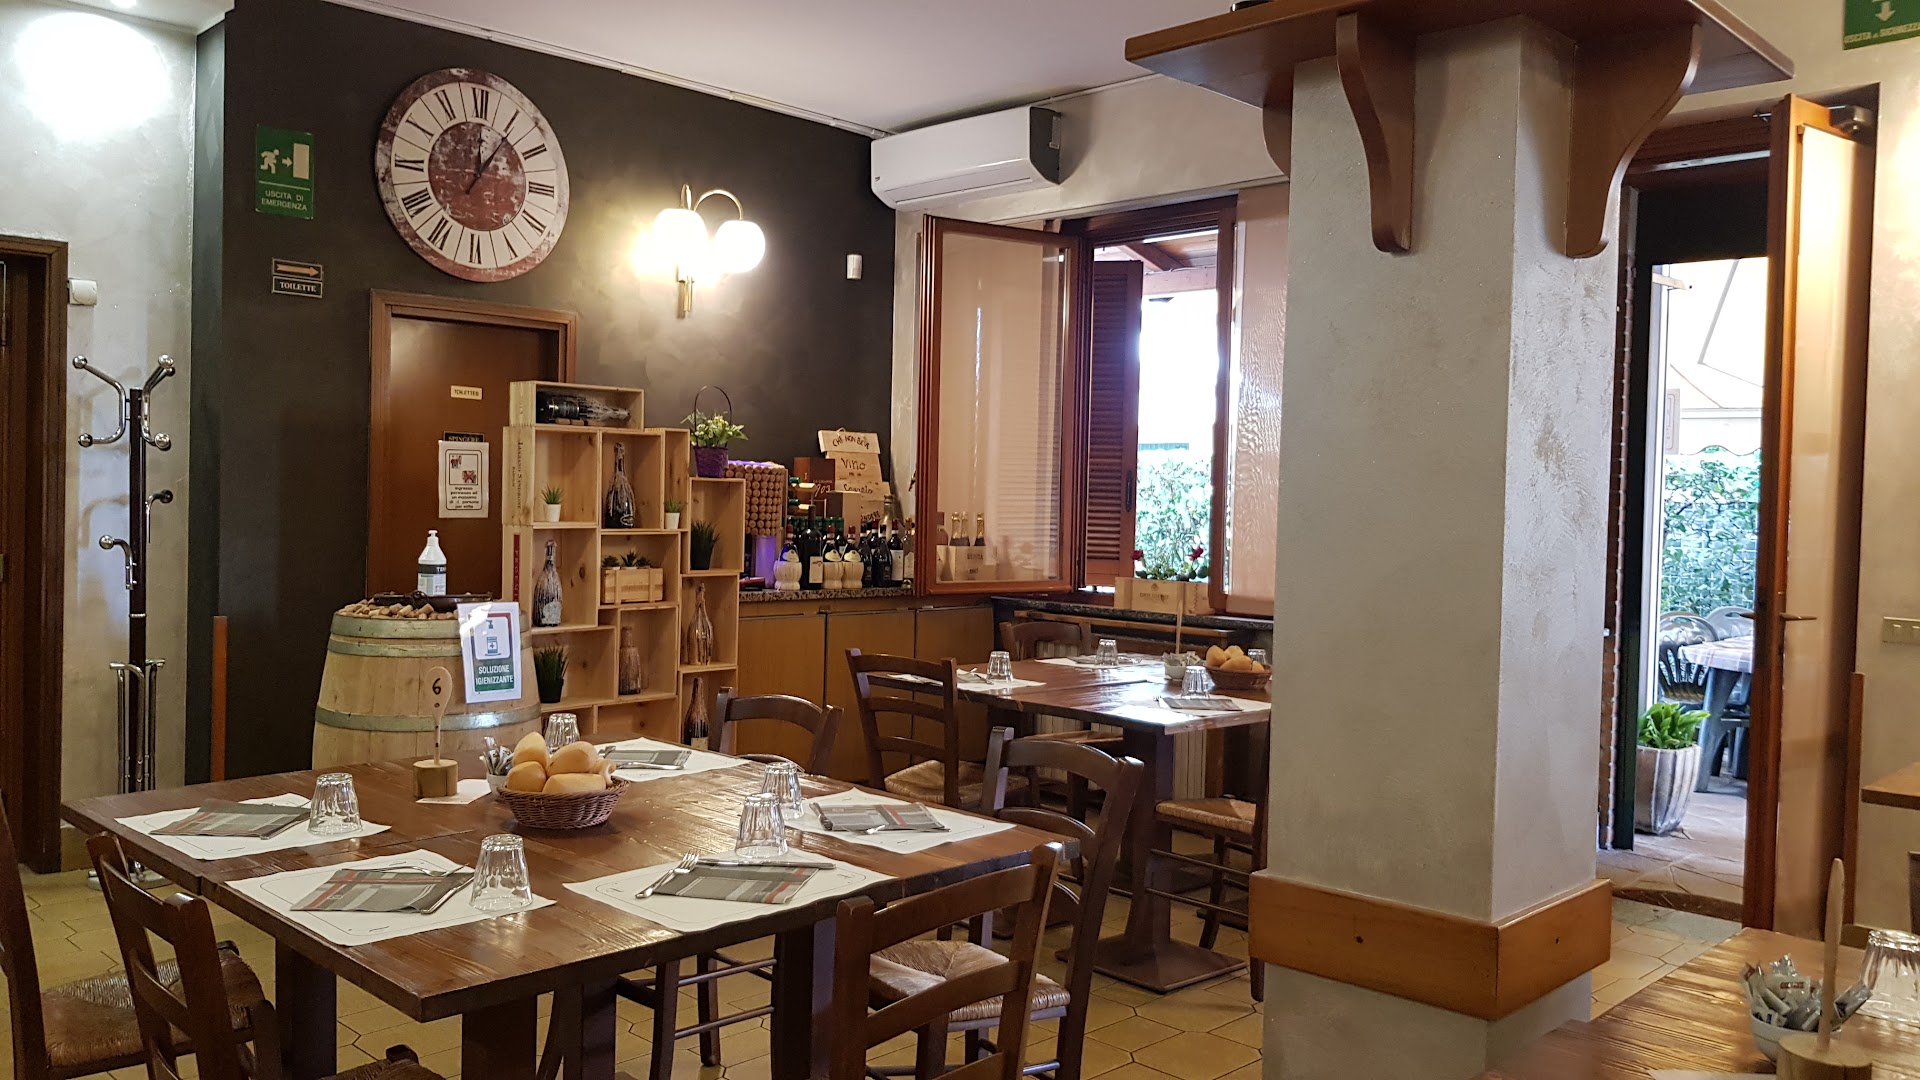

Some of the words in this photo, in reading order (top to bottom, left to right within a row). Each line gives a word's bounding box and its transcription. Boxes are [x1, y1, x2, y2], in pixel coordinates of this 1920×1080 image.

[265, 190, 292, 201] USCITA
[296, 194, 304, 202] DI
[261, 198, 308, 211] EMERGENZA
[279, 281, 317, 293] TOILETTE
[840, 457, 867, 471] Vino
[478, 664, 510, 675] SOLUZIONE
[432, 677, 442, 695] 6
[475, 675, 514, 686] IGIENIZZANTE
